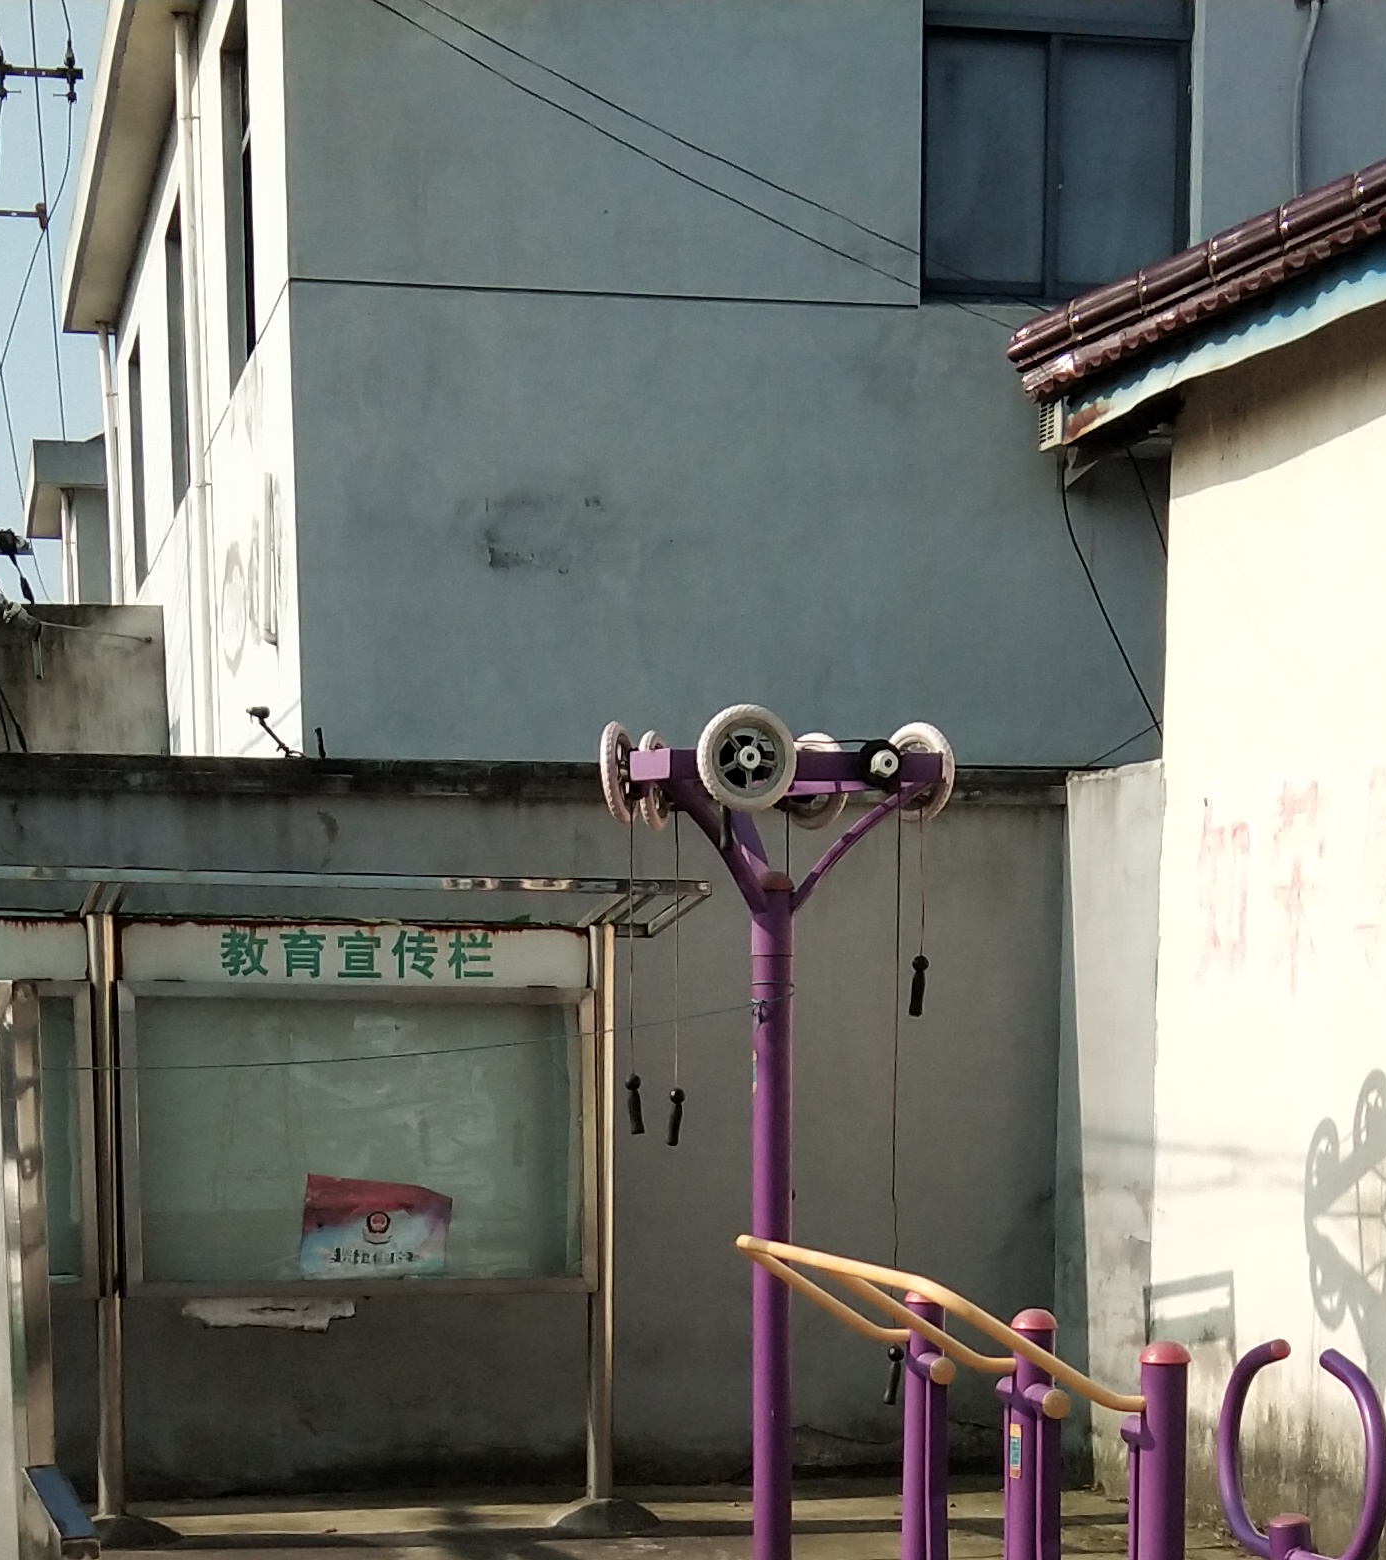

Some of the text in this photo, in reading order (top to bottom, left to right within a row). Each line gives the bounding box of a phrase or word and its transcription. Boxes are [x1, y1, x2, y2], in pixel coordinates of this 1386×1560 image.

[221, 928, 494, 979] 教育宣传栏
